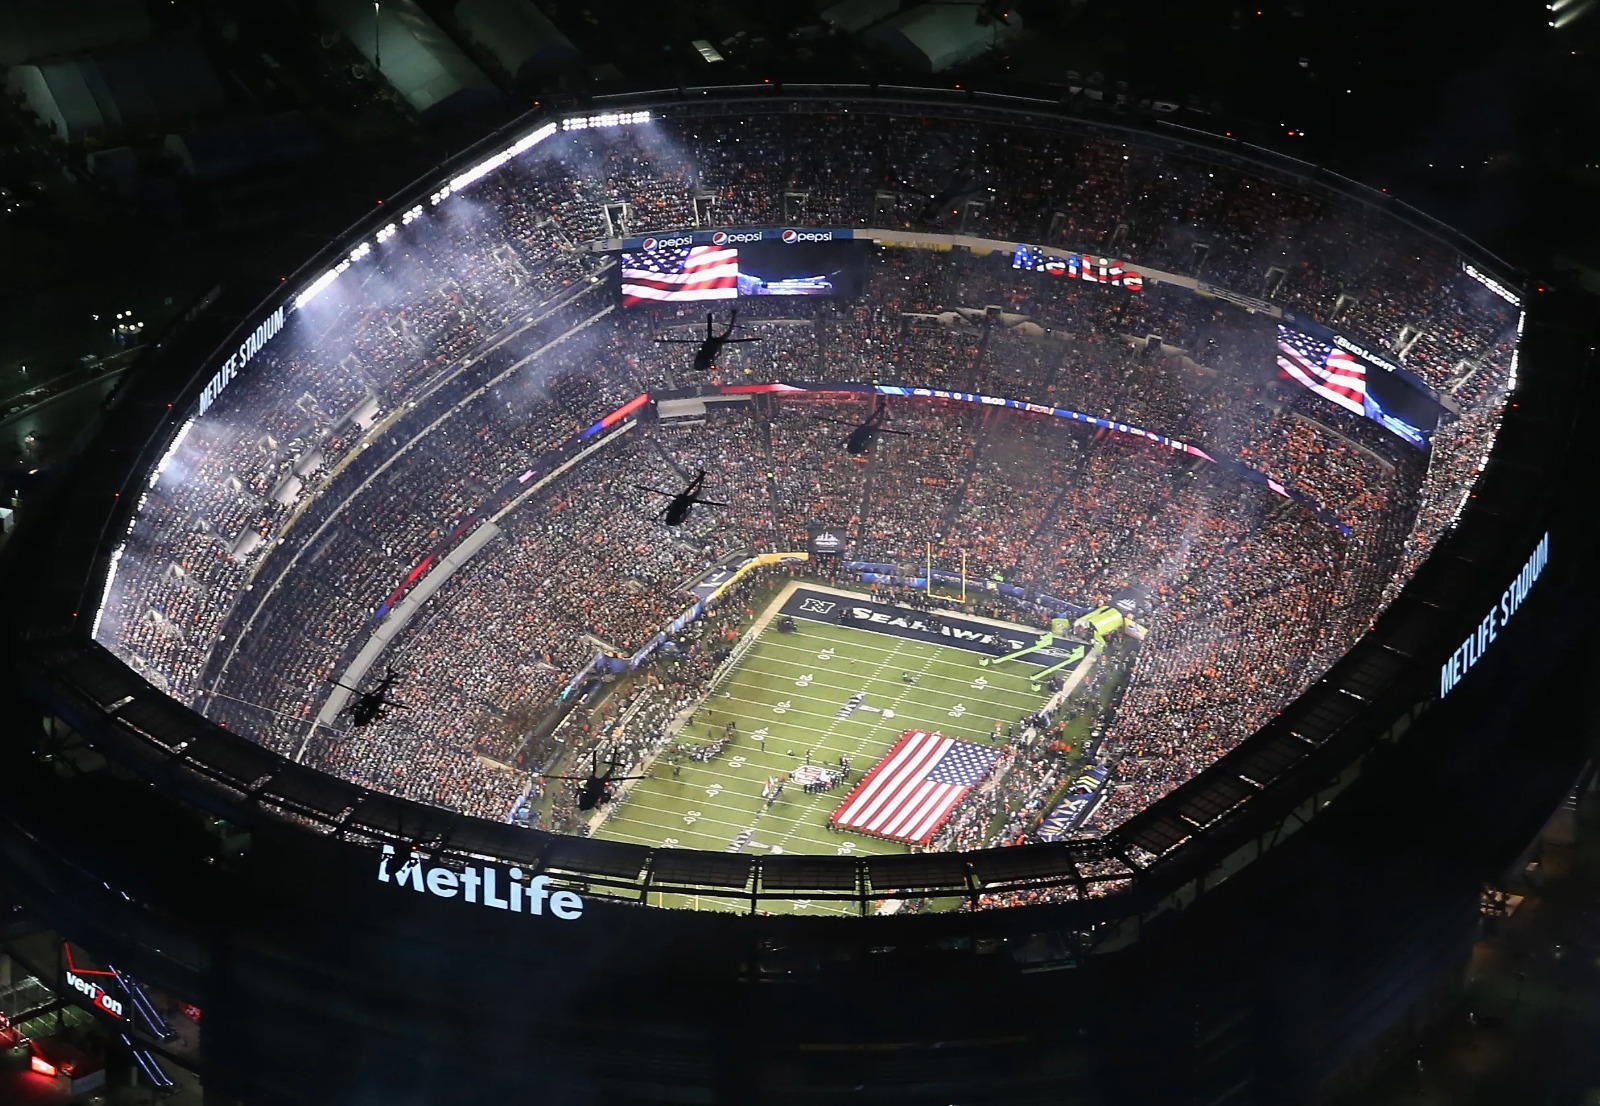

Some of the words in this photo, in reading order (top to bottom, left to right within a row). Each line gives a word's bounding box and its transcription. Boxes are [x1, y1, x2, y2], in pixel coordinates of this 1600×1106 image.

[658, 235, 693, 249] pepsi
[727, 231, 763, 244] pepsi
[797, 231, 832, 243] pepsi
[1012, 243, 1143, 291] MetLife
[200, 352, 238, 417] METLIFE
[239, 305, 284, 368] STADIUM
[1337, 336, 1364, 354] BUD
[1362, 350, 1397, 373] LIGHT
[1441, 605, 1498, 699] METLIFE
[1501, 531, 1549, 627] STADIUM
[377, 844, 584, 920] MetLife
[66, 971, 123, 1018] verizon
